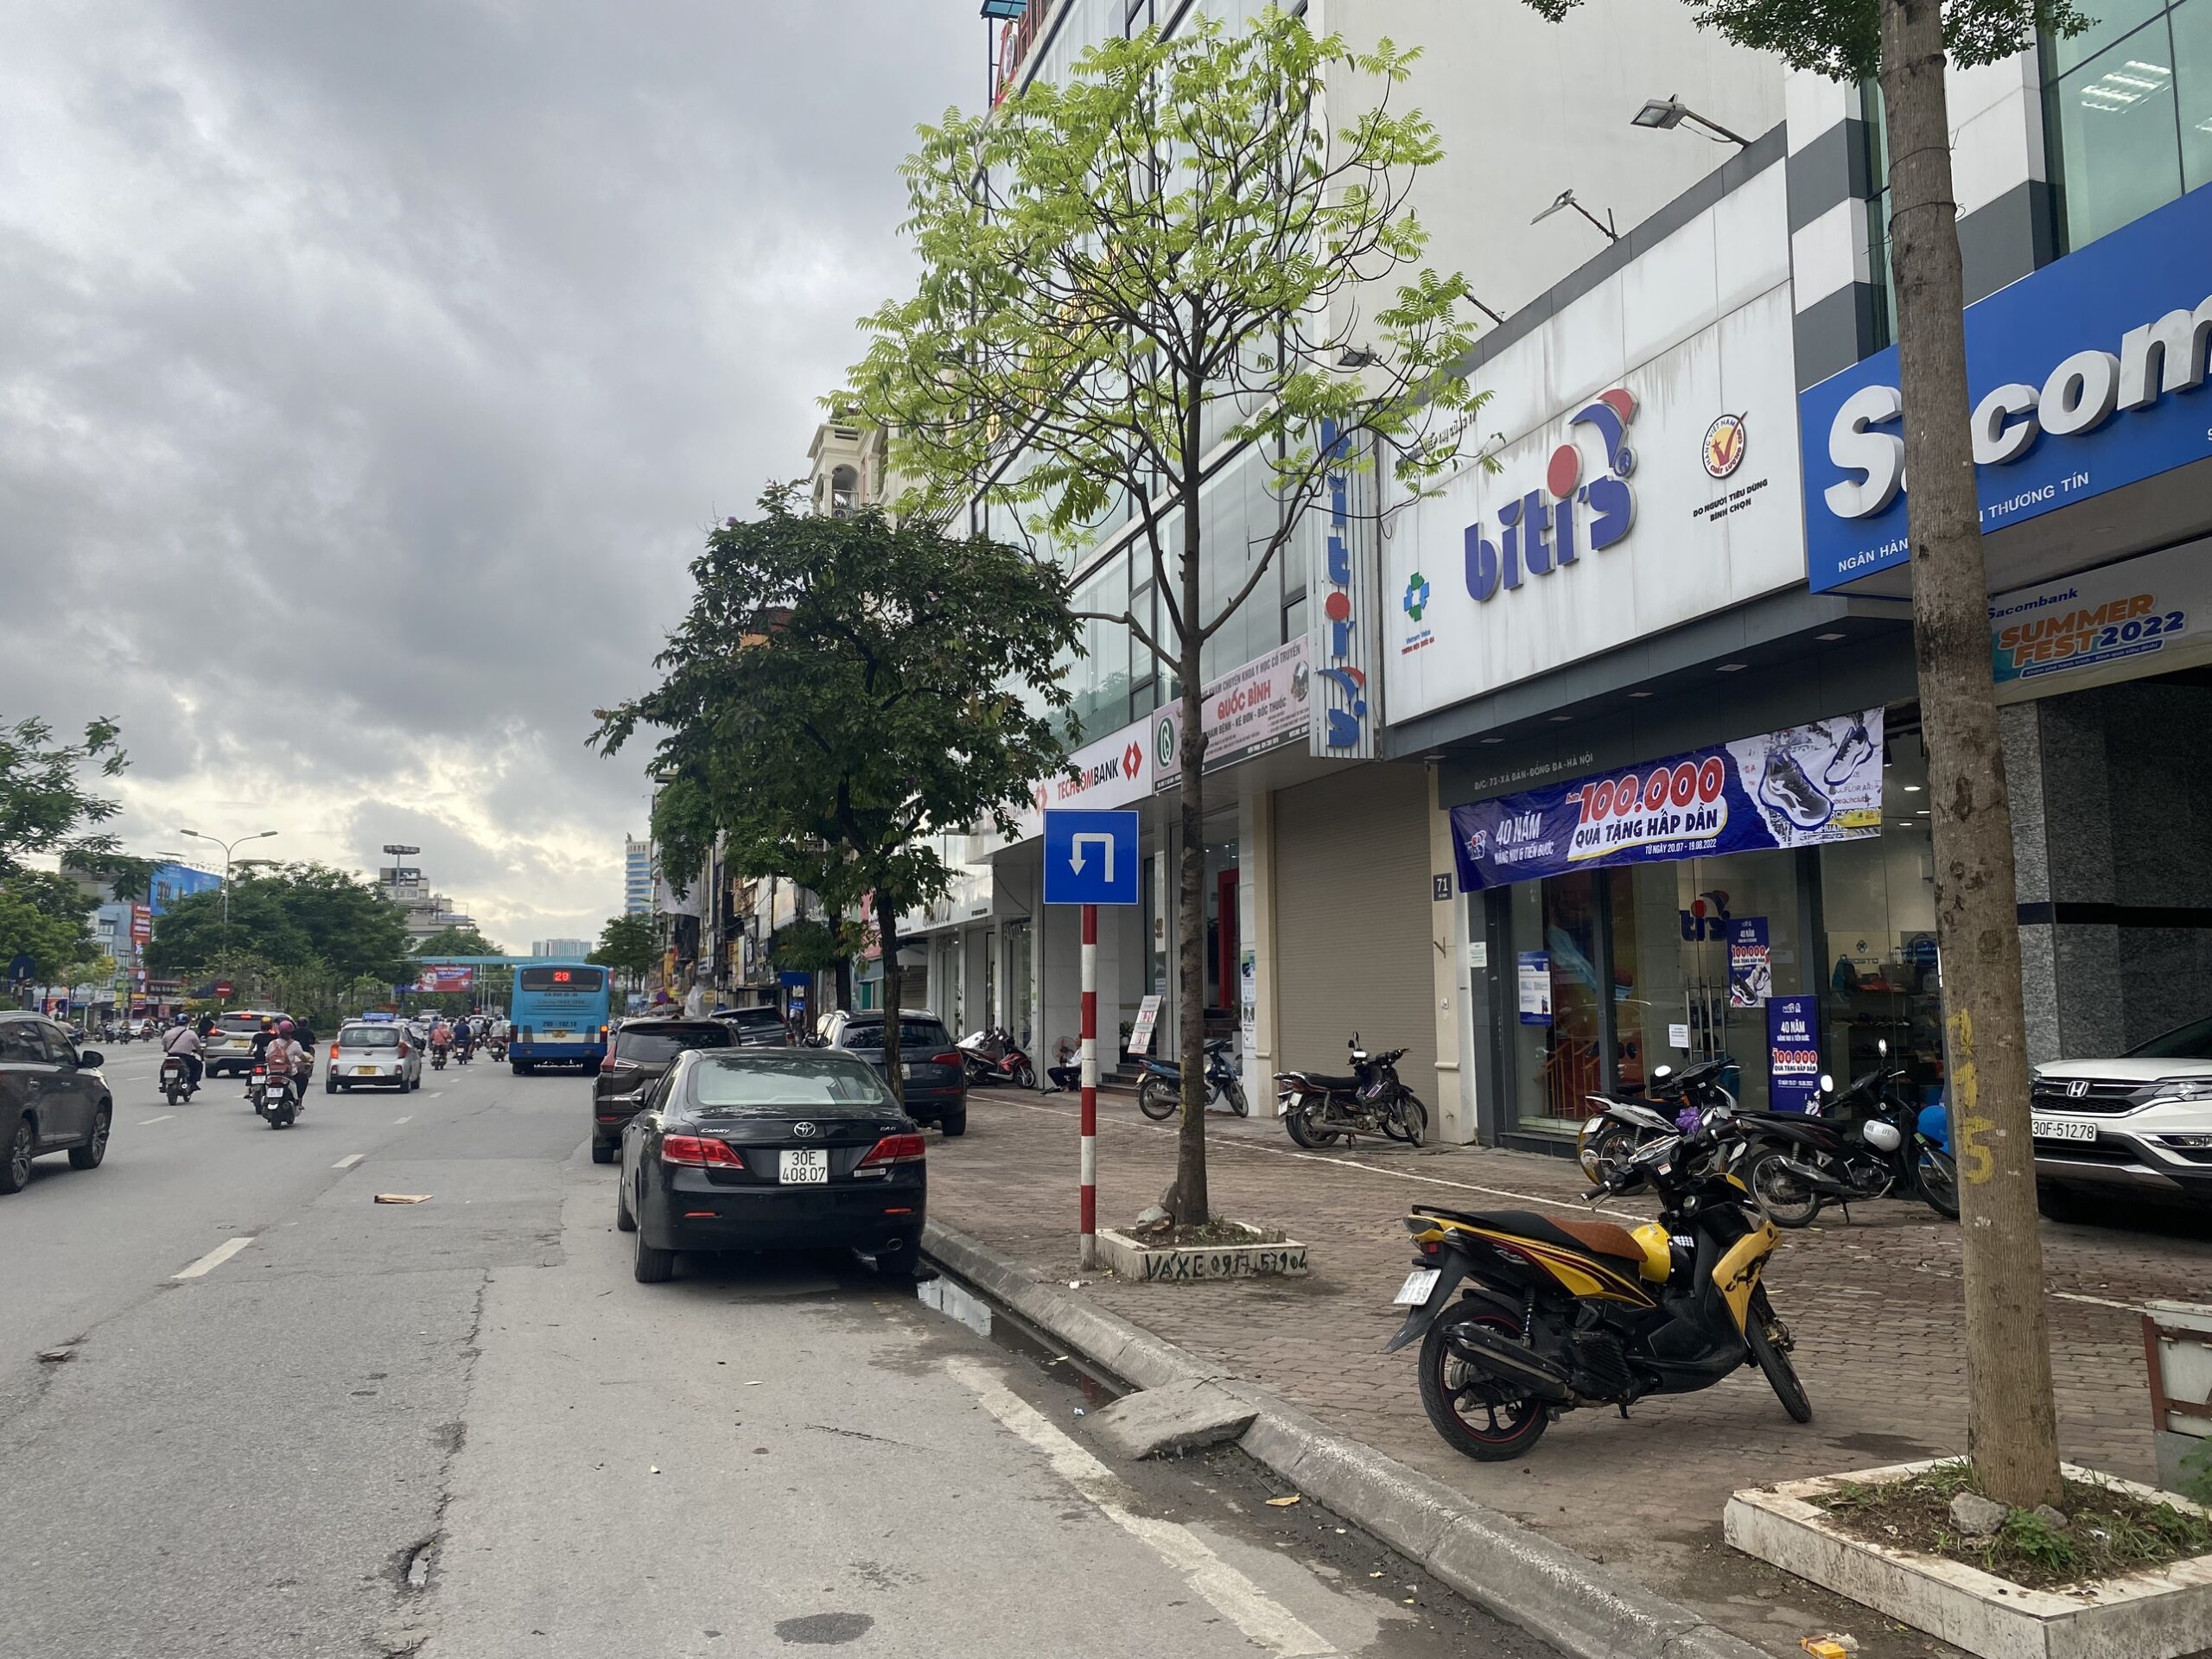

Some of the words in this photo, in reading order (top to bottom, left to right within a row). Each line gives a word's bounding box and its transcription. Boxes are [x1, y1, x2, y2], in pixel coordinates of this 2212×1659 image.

[1824, 294, 2212, 518] Scom
[1709, 423, 1719, 437] VIỆT
[1694, 508, 1704, 518] DO
[1704, 496, 1727, 512] NGƯỜI
[1728, 487, 1745, 502] TIÊU
[1746, 478, 1768, 494] DÙNG
[1710, 508, 1728, 522] BÌNH
[1729, 498, 1751, 513] CHỌN
[1838, 550, 1875, 573] NGÂN
[1879, 537, 1909, 559] HÀN
[1988, 485, 2056, 518] THƯƠNG
[2061, 472, 2089, 492] TÍN
[1988, 588, 2078, 620] Sacombank
[2000, 594, 2154, 648] SUMMER
[2013, 628, 2098, 666] FEST
[2100, 611, 2184, 646] 2022
[1217, 687, 1245, 720] QUỐC
[1248, 679, 1271, 707] BÌNH
[1207, 727, 1218, 738] HÁM
[1580, 751, 1593, 767] NỘI
[1580, 756, 1725, 823] 100.000
[1496, 820, 1512, 846] 40
[1513, 810, 1542, 843] NĂM
[1605, 819, 1643, 845] TẶNG
[1647, 809, 1681, 836] HẤP
[1686, 802, 1718, 832] DẪN
[1668, 842, 1683, 853] 20.07
[1688, 838, 1717, 851] 19.08.2022
[1437, 878, 1448, 892] 71
[1732, 945, 1766, 957] 100.000
[1781, 1020, 1789, 1033] 40
[1790, 1019, 1805, 1033] NĂM
[1773, 1051, 1817, 1064] 100.000
[2032, 1122, 2094, 1140] 30F-512.78
[791, 1151, 816, 1166] 30E
[782, 1166, 826, 1182] 408.07
